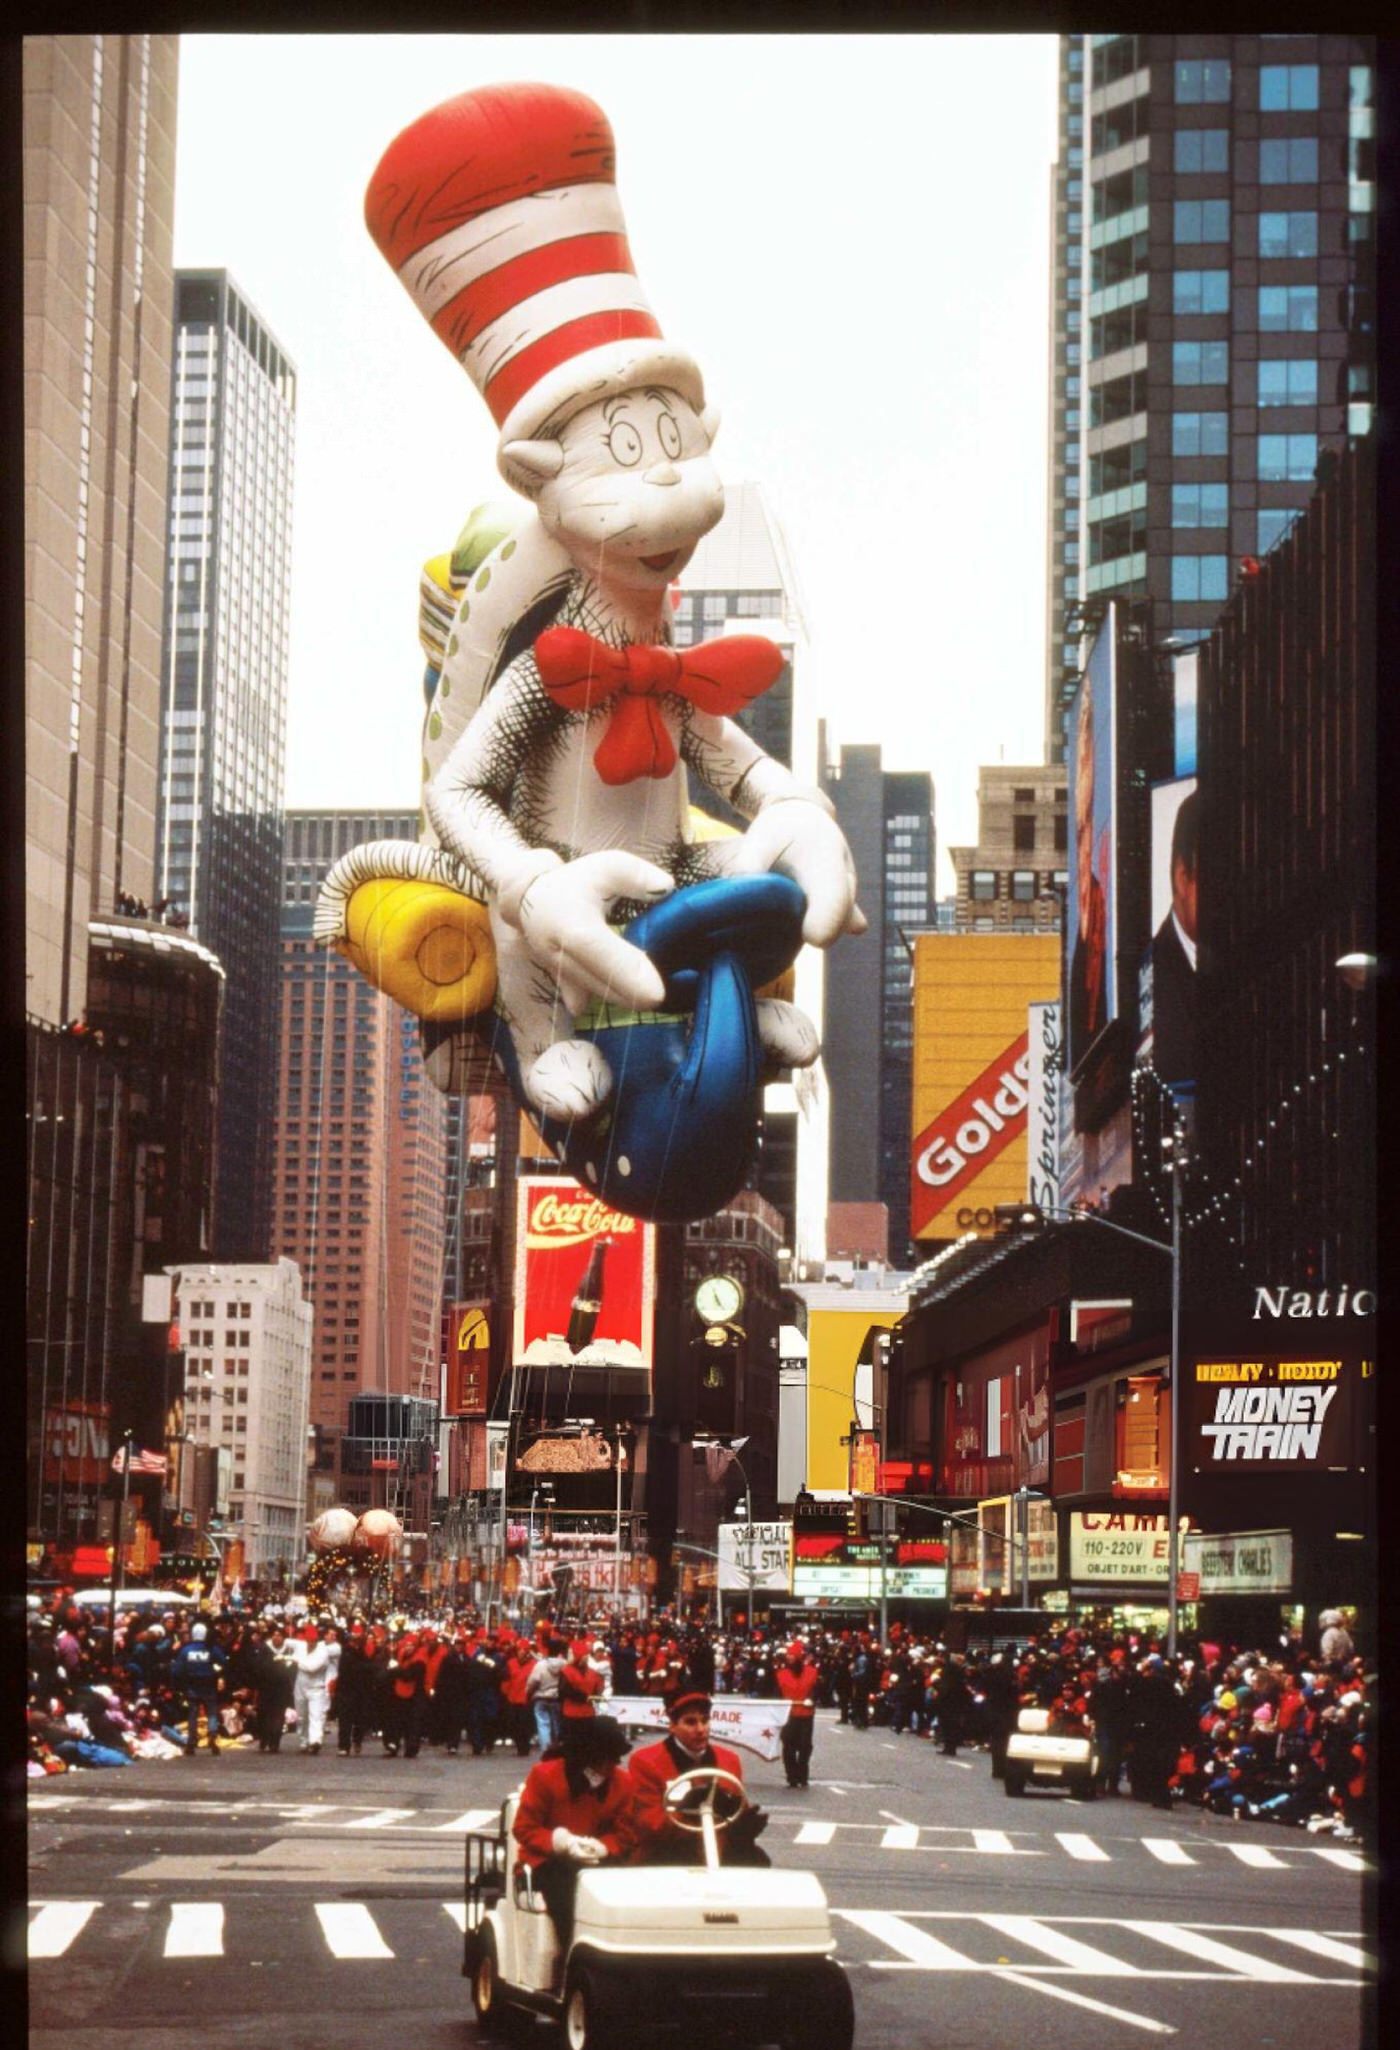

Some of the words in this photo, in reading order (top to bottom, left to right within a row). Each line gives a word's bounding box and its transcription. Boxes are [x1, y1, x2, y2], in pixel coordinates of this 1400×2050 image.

[956, 1207, 996, 1230] CO
[1213, 1384, 1338, 1424] MONEY
[1200, 1423, 1322, 1460] TRAIN
[1084, 1539, 1144, 1556] 110-220V
[1087, 1563, 1118, 1575] OBJET
[709, 1709, 743, 1725] RADE
